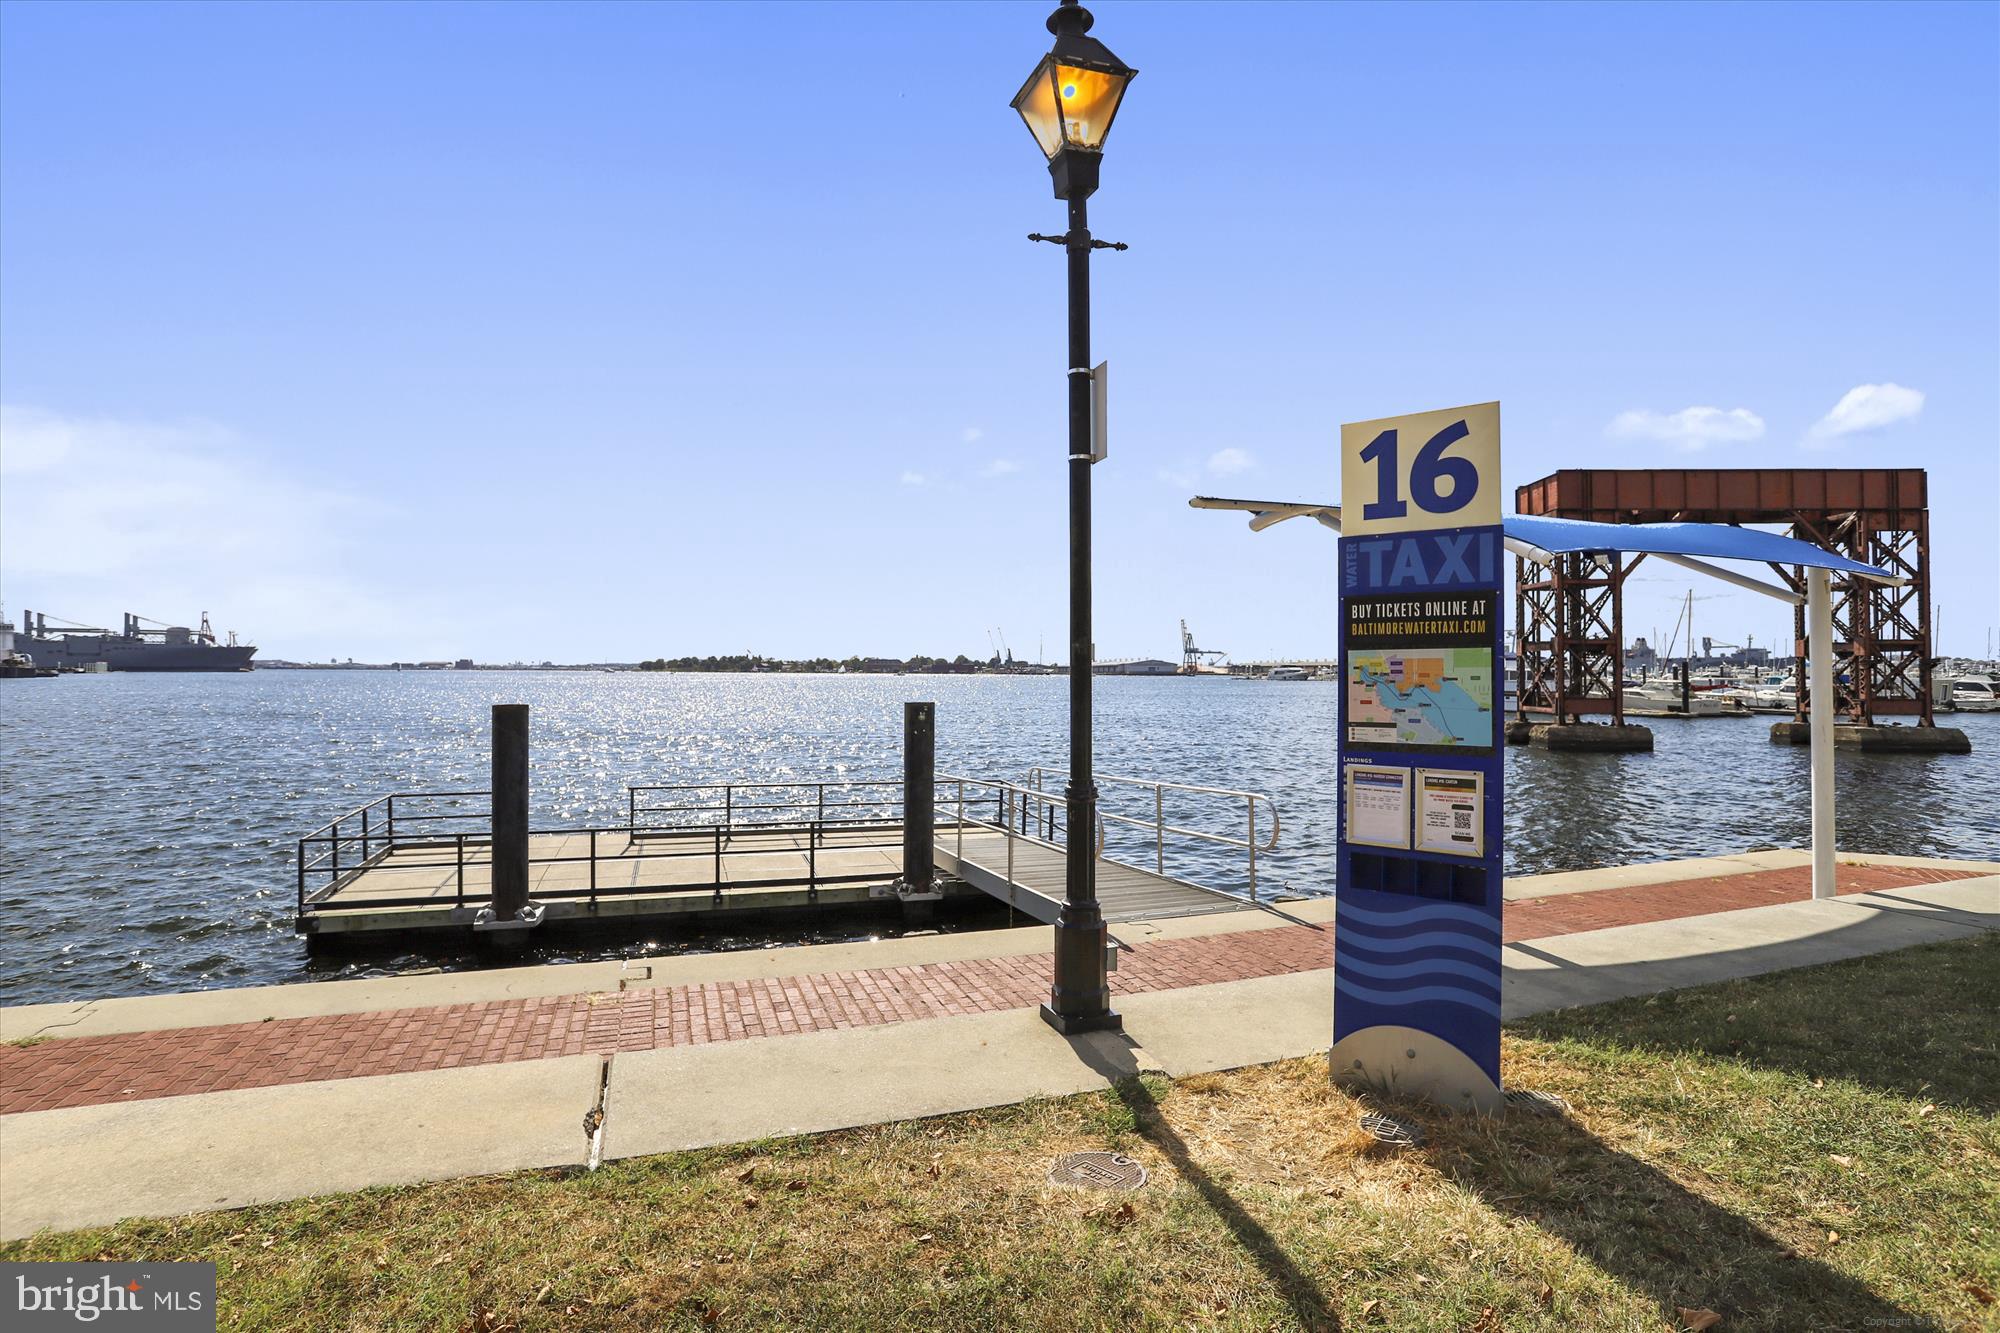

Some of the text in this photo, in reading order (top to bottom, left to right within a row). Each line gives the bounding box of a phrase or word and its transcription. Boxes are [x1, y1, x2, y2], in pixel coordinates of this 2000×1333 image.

[1359, 419, 1479, 520] 16
[1346, 543, 1358, 588] WATER
[1360, 532, 1494, 588] TAXI
[1352, 600, 1486, 619] BUY TICKETS ONLINE AT
[1352, 620, 1486, 636] BALTIMOREWATERTAXI.COM
[1343, 756, 1373, 764] LANDINGS
